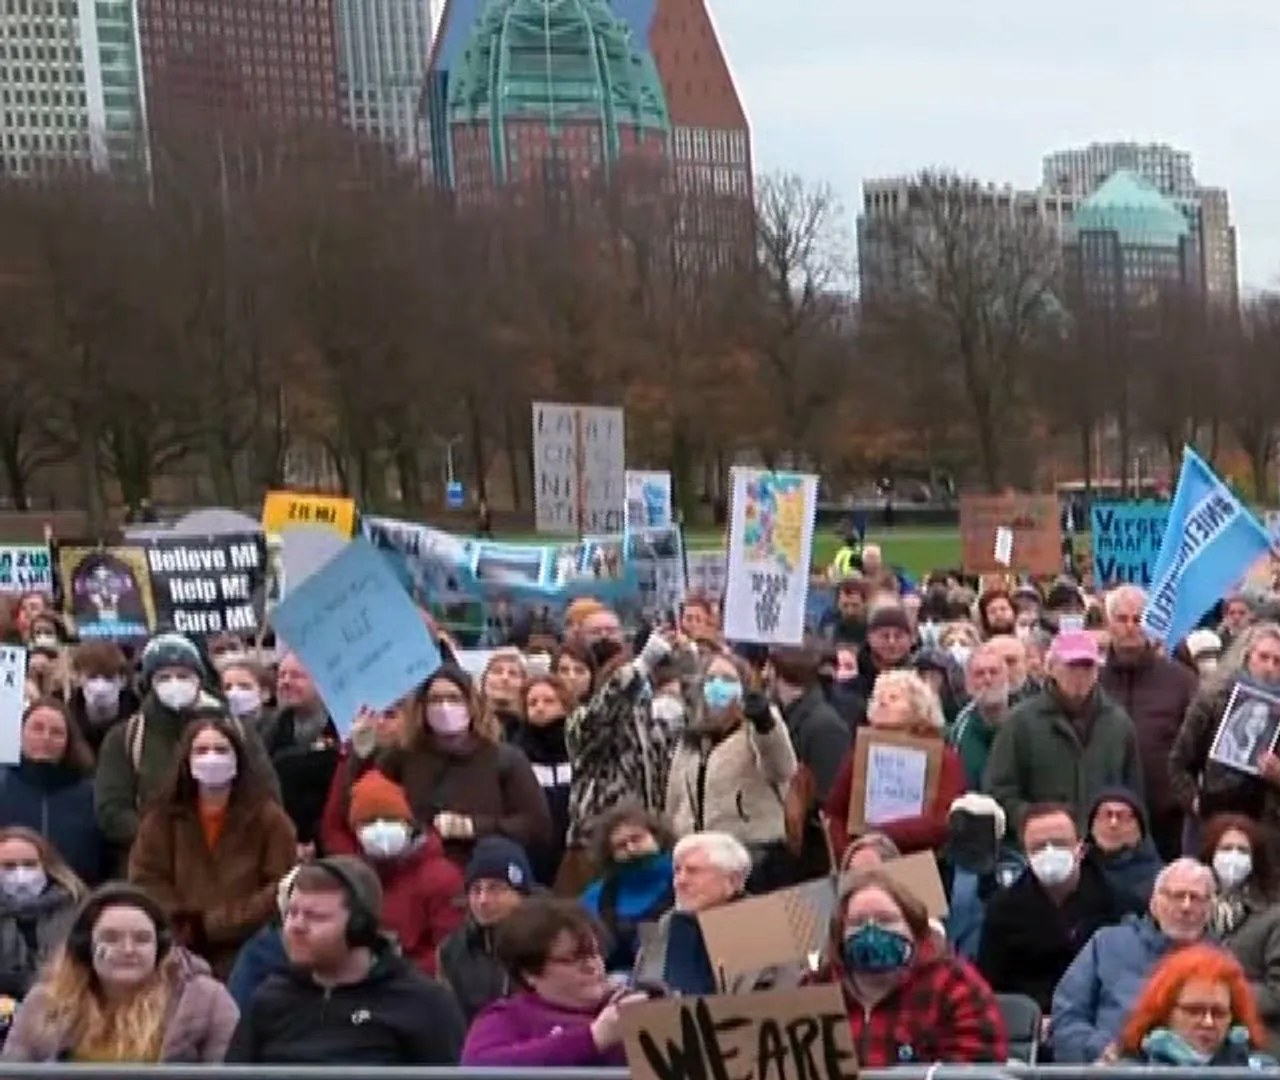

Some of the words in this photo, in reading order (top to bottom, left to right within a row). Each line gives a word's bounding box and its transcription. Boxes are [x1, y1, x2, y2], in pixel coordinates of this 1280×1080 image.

[149, 545, 226, 572] Believe
[169, 576, 217, 604] Help
[220, 573, 250, 600] ME
[173, 607, 222, 633] Cure
[225, 603, 258, 632] ME
